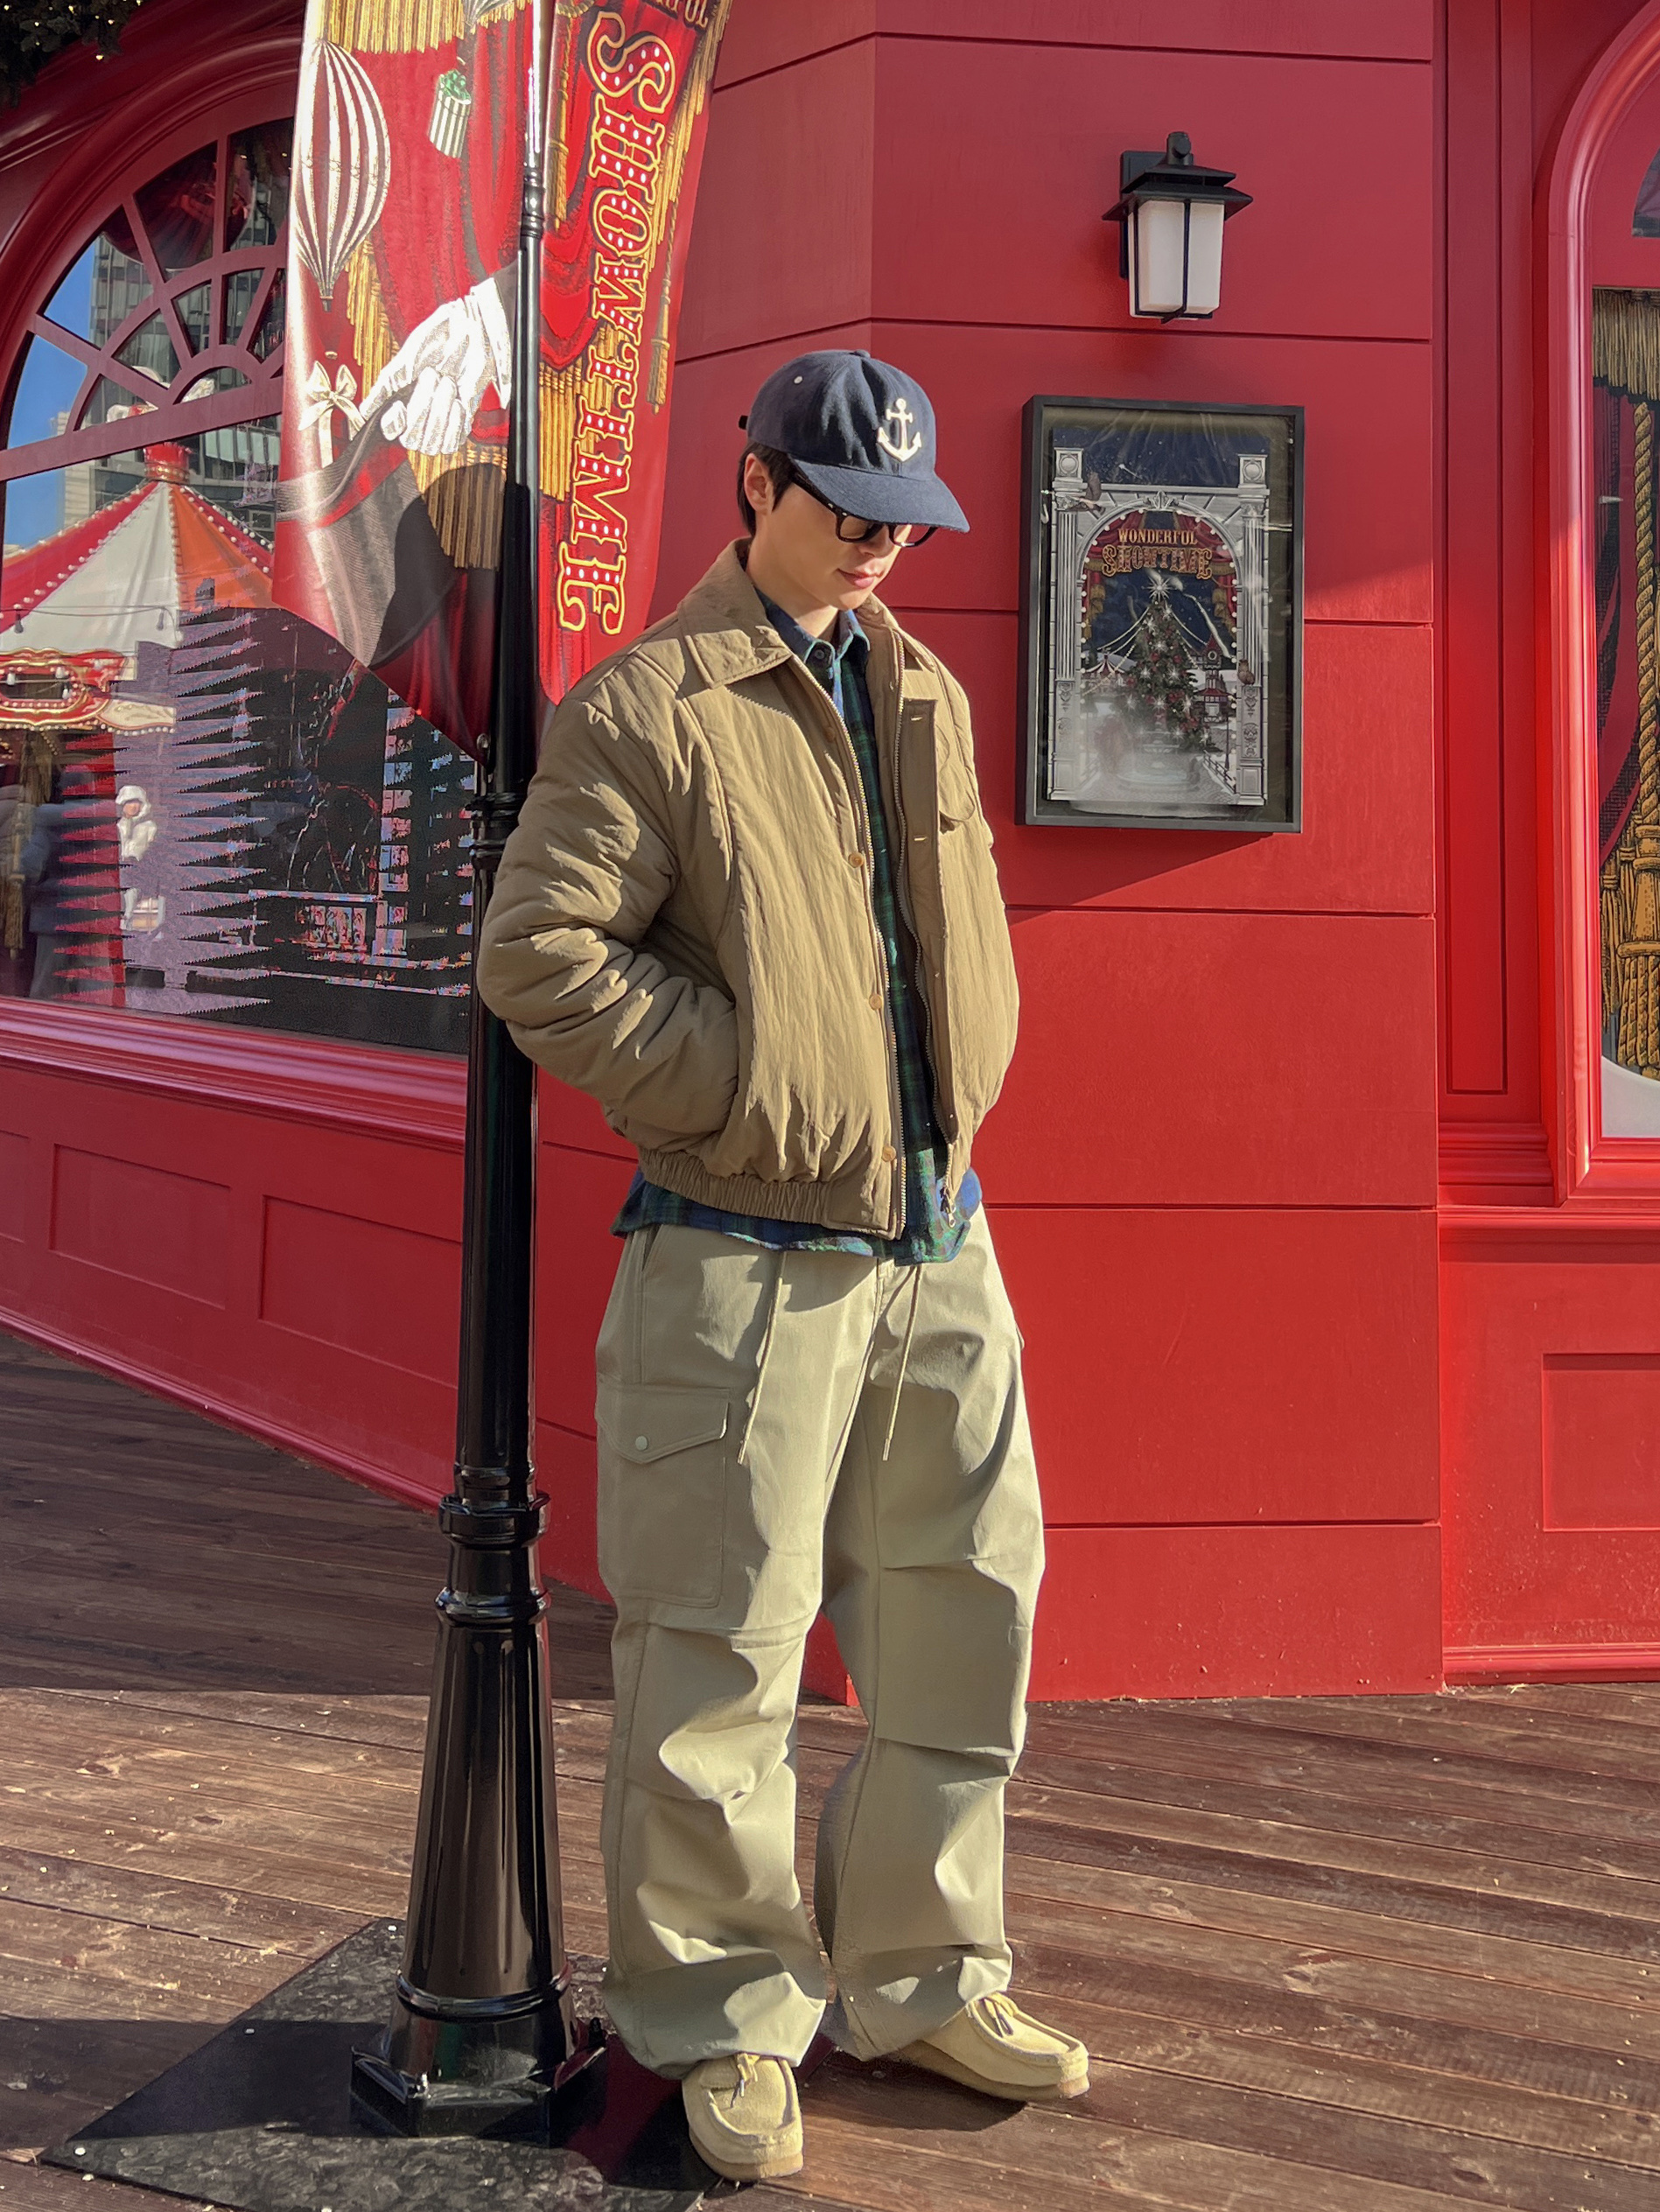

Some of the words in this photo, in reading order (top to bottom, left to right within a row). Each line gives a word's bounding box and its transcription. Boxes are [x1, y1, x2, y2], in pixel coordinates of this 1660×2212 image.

[557, 10, 676, 635] SHOWTIME
[1117, 528, 1198, 544] WONDERFUL
[1102, 544, 1213, 579] SHOWTIME
